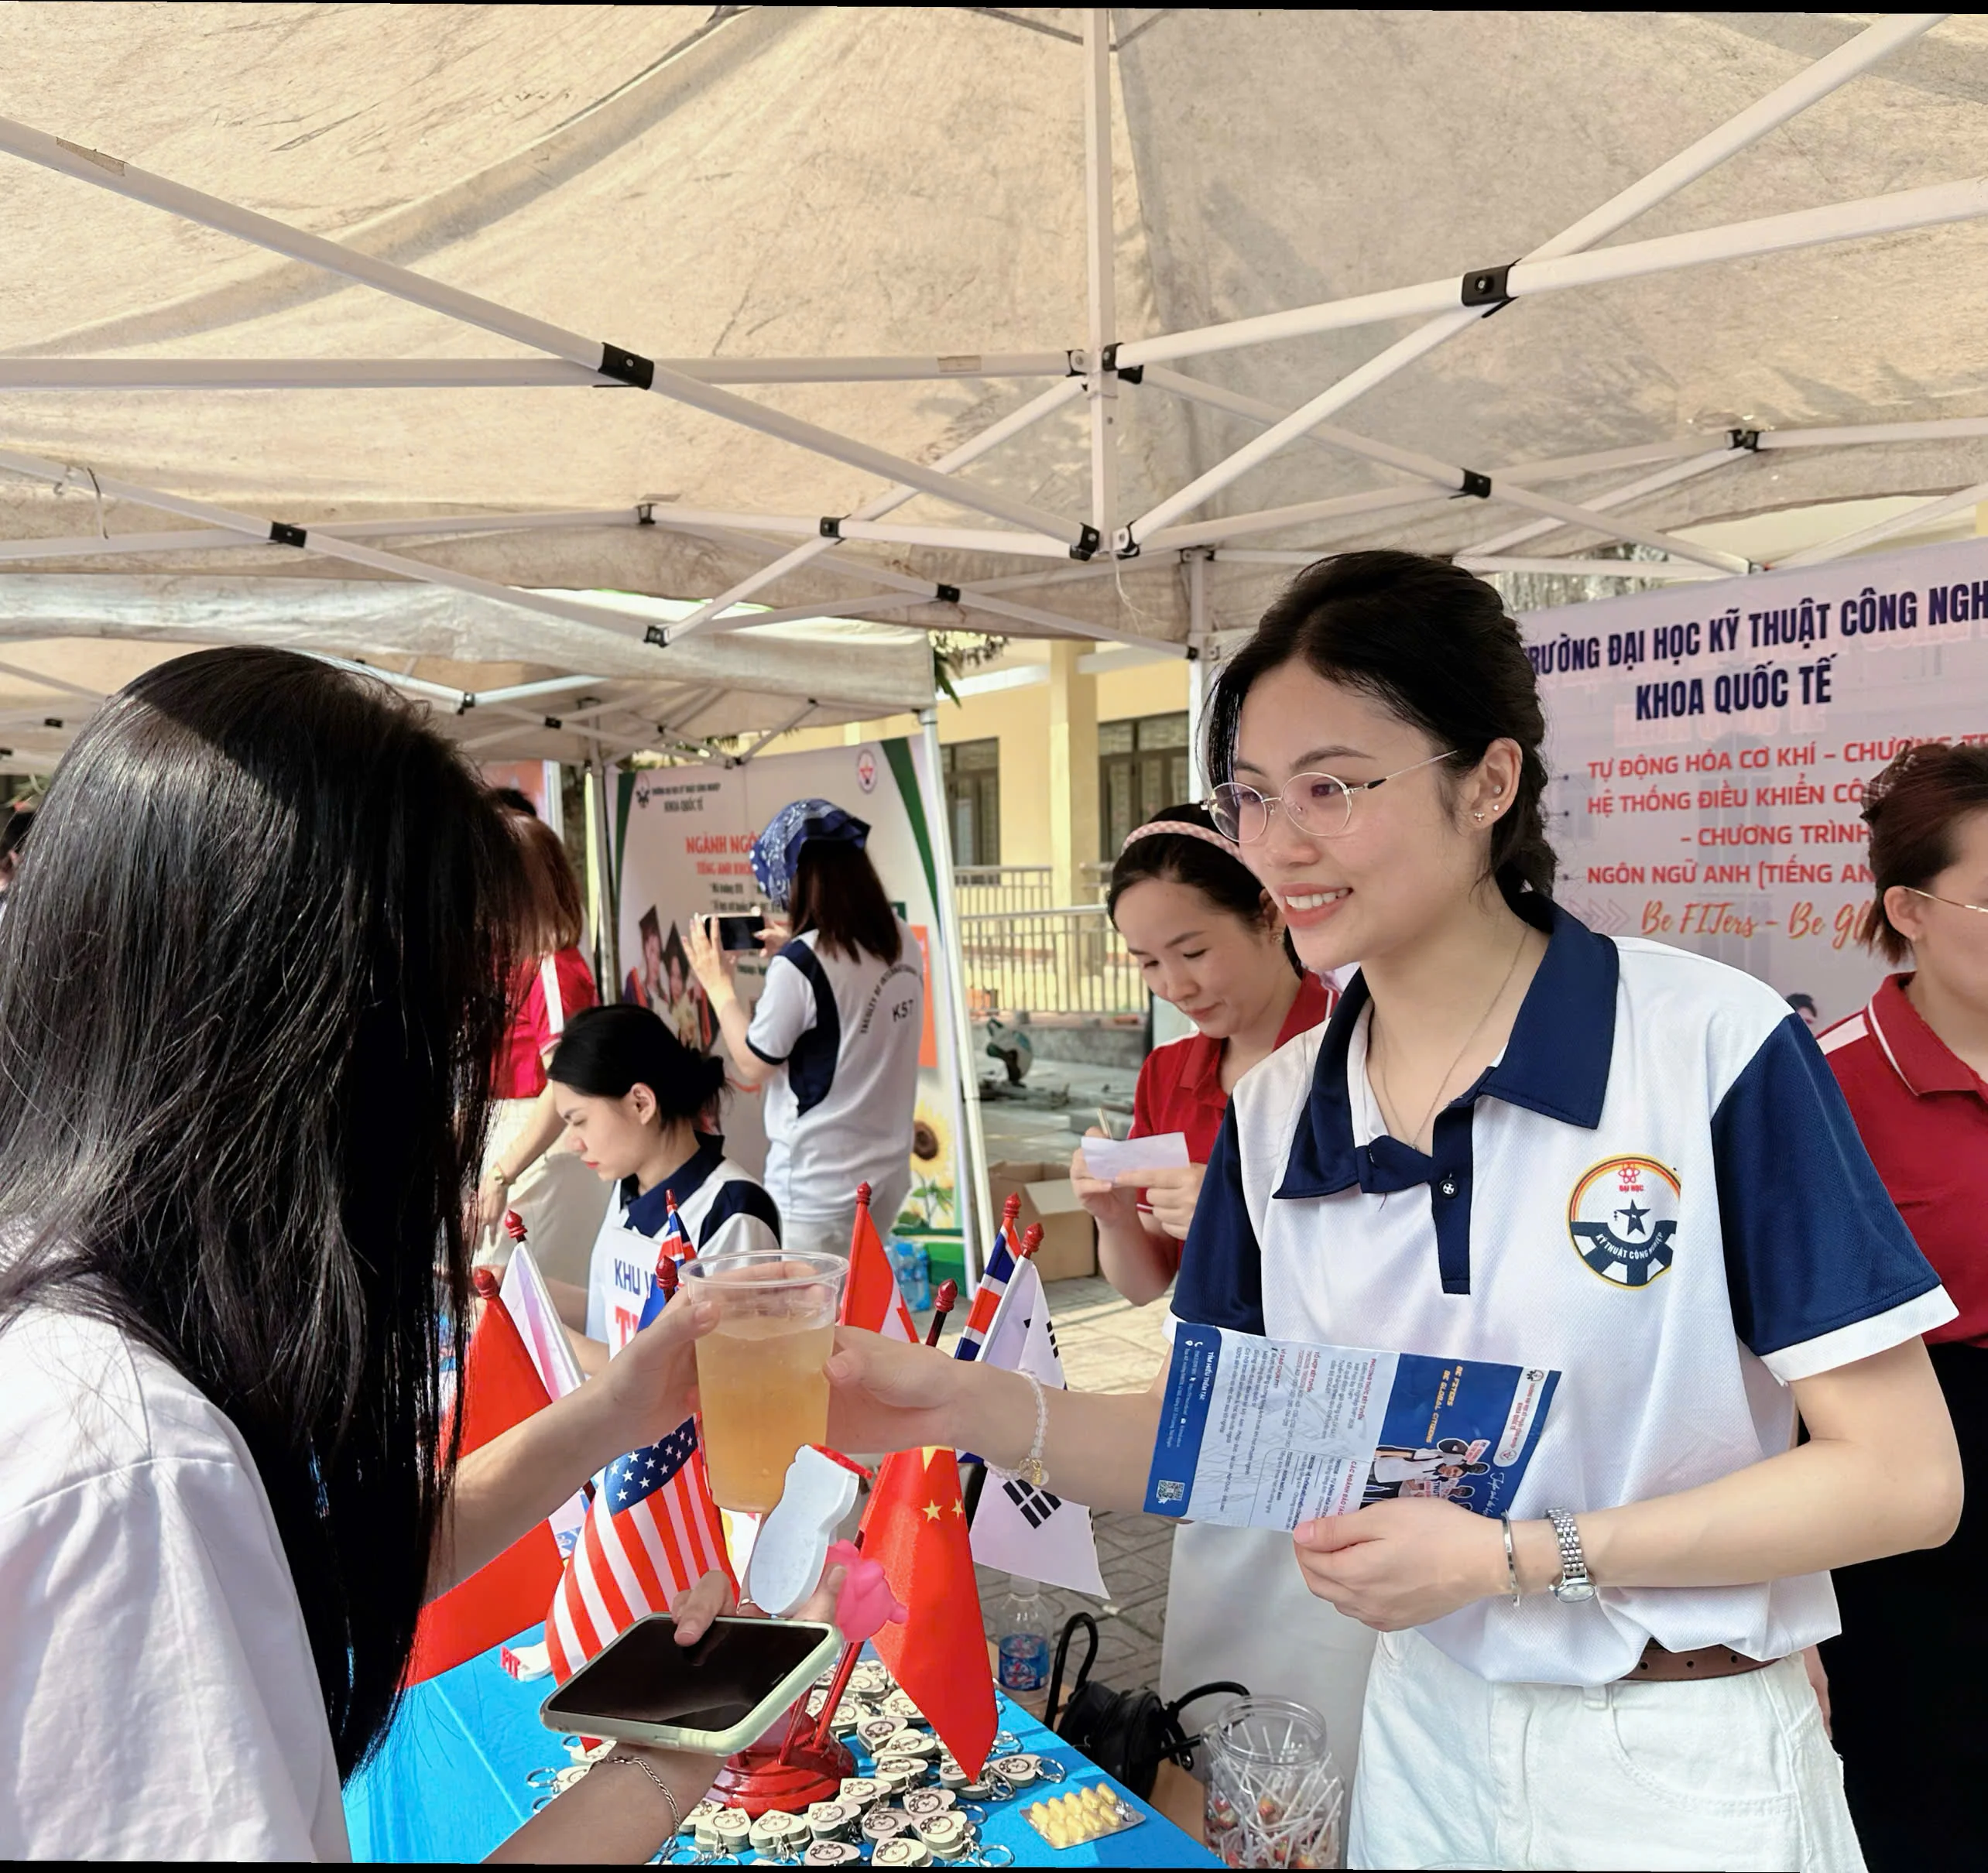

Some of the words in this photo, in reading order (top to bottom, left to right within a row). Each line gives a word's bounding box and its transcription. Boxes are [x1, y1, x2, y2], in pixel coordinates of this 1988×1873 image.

[1524, 633, 1599, 675] RƯỜNG
[1608, 630, 1644, 670] ĐẠI
[1653, 622, 1700, 666] HỌC
[1709, 608, 1740, 652] KỸ
[1749, 598, 1831, 649] THUẬT
[1841, 587, 1917, 636] CÔNG
[1636, 679, 1704, 721] KHOA
[1715, 661, 1788, 714] QUỐC
[1799, 653, 1838, 705] TẾ
[1588, 757, 1614, 782] TỰ
[1619, 753, 1678, 780] ĐỘNG
[1685, 748, 1732, 772] HÓA
[1739, 746, 1770, 769] CƠ
[1777, 741, 1816, 766] KHÍ
[1588, 788, 1613, 818] HỆ
[1619, 784, 1691, 812] THỐNG
[1698, 779, 1748, 809] ĐIỀU
[1756, 772, 1824, 806] KHIỂN
[730, 830, 761, 853] NGÔ
[1698, 823, 1792, 846] CHƯƠNG
[1800, 819, 1870, 844] TRÌNH
[1588, 861, 1644, 883] NGÔN
[1652, 858, 1698, 883] NGỮ
[1703, 865, 1750, 883] ANH
[1641, 900, 1673, 934] Be
[1788, 901, 1825, 938] Be
[614, 1258, 640, 1296] KHU
[1433, 1381, 1447, 1410] GLOBAL
